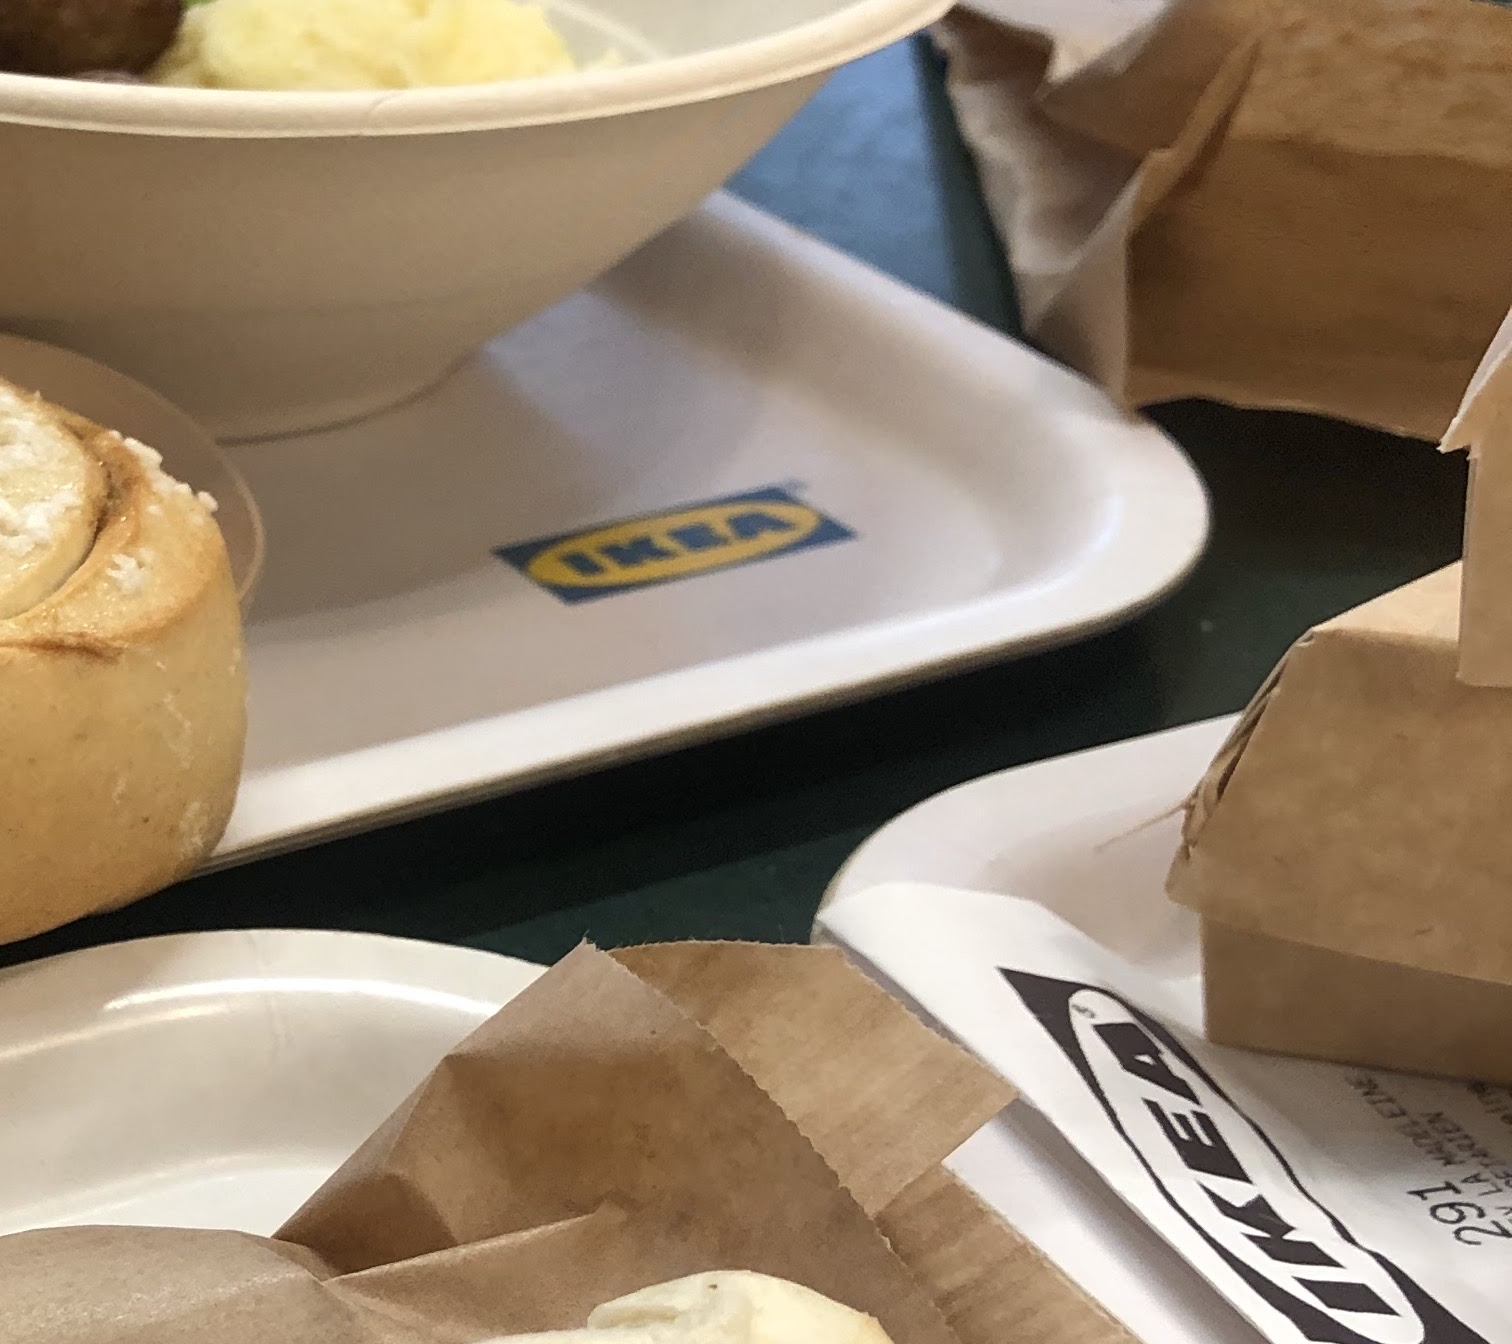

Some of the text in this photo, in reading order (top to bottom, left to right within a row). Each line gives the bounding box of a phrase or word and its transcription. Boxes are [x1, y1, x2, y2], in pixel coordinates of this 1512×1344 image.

[556, 511, 797, 578] IKEA
[1091, 1021, 1402, 1317] IKEA
[1405, 1179, 1512, 1246] 291
